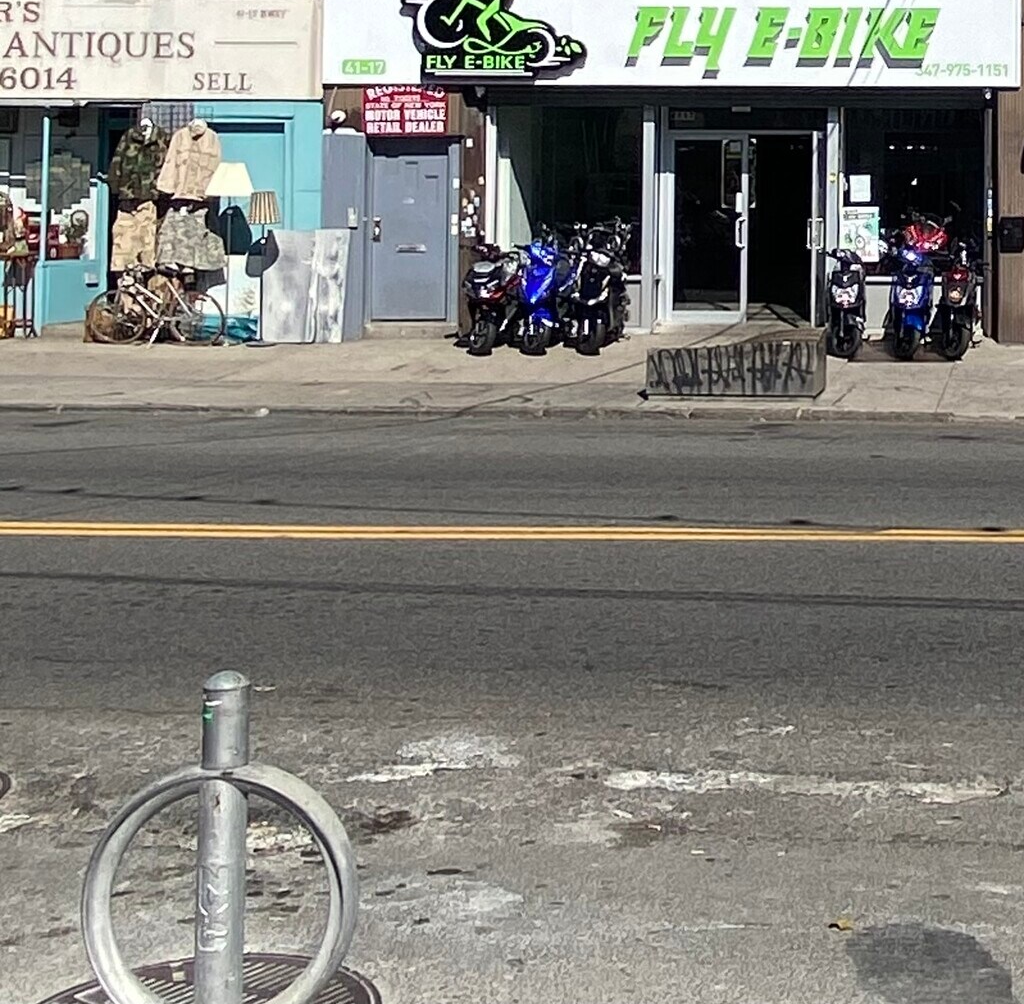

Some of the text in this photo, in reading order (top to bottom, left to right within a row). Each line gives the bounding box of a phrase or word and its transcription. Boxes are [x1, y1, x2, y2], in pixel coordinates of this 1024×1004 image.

[3, 31, 196, 63] ANTIQUES
[626, 6, 942, 74] FLY E-BIKE
[344, 61, 385, 74] 41-17
[426, 55, 525, 69] FLY E-BIKE
[0, 66, 77, 91] 6014
[192, 72, 252, 92] SELL
[365, 108, 446, 121] MOTOR VEHICLE
[366, 121, 445, 134] RETAIL DEALER
